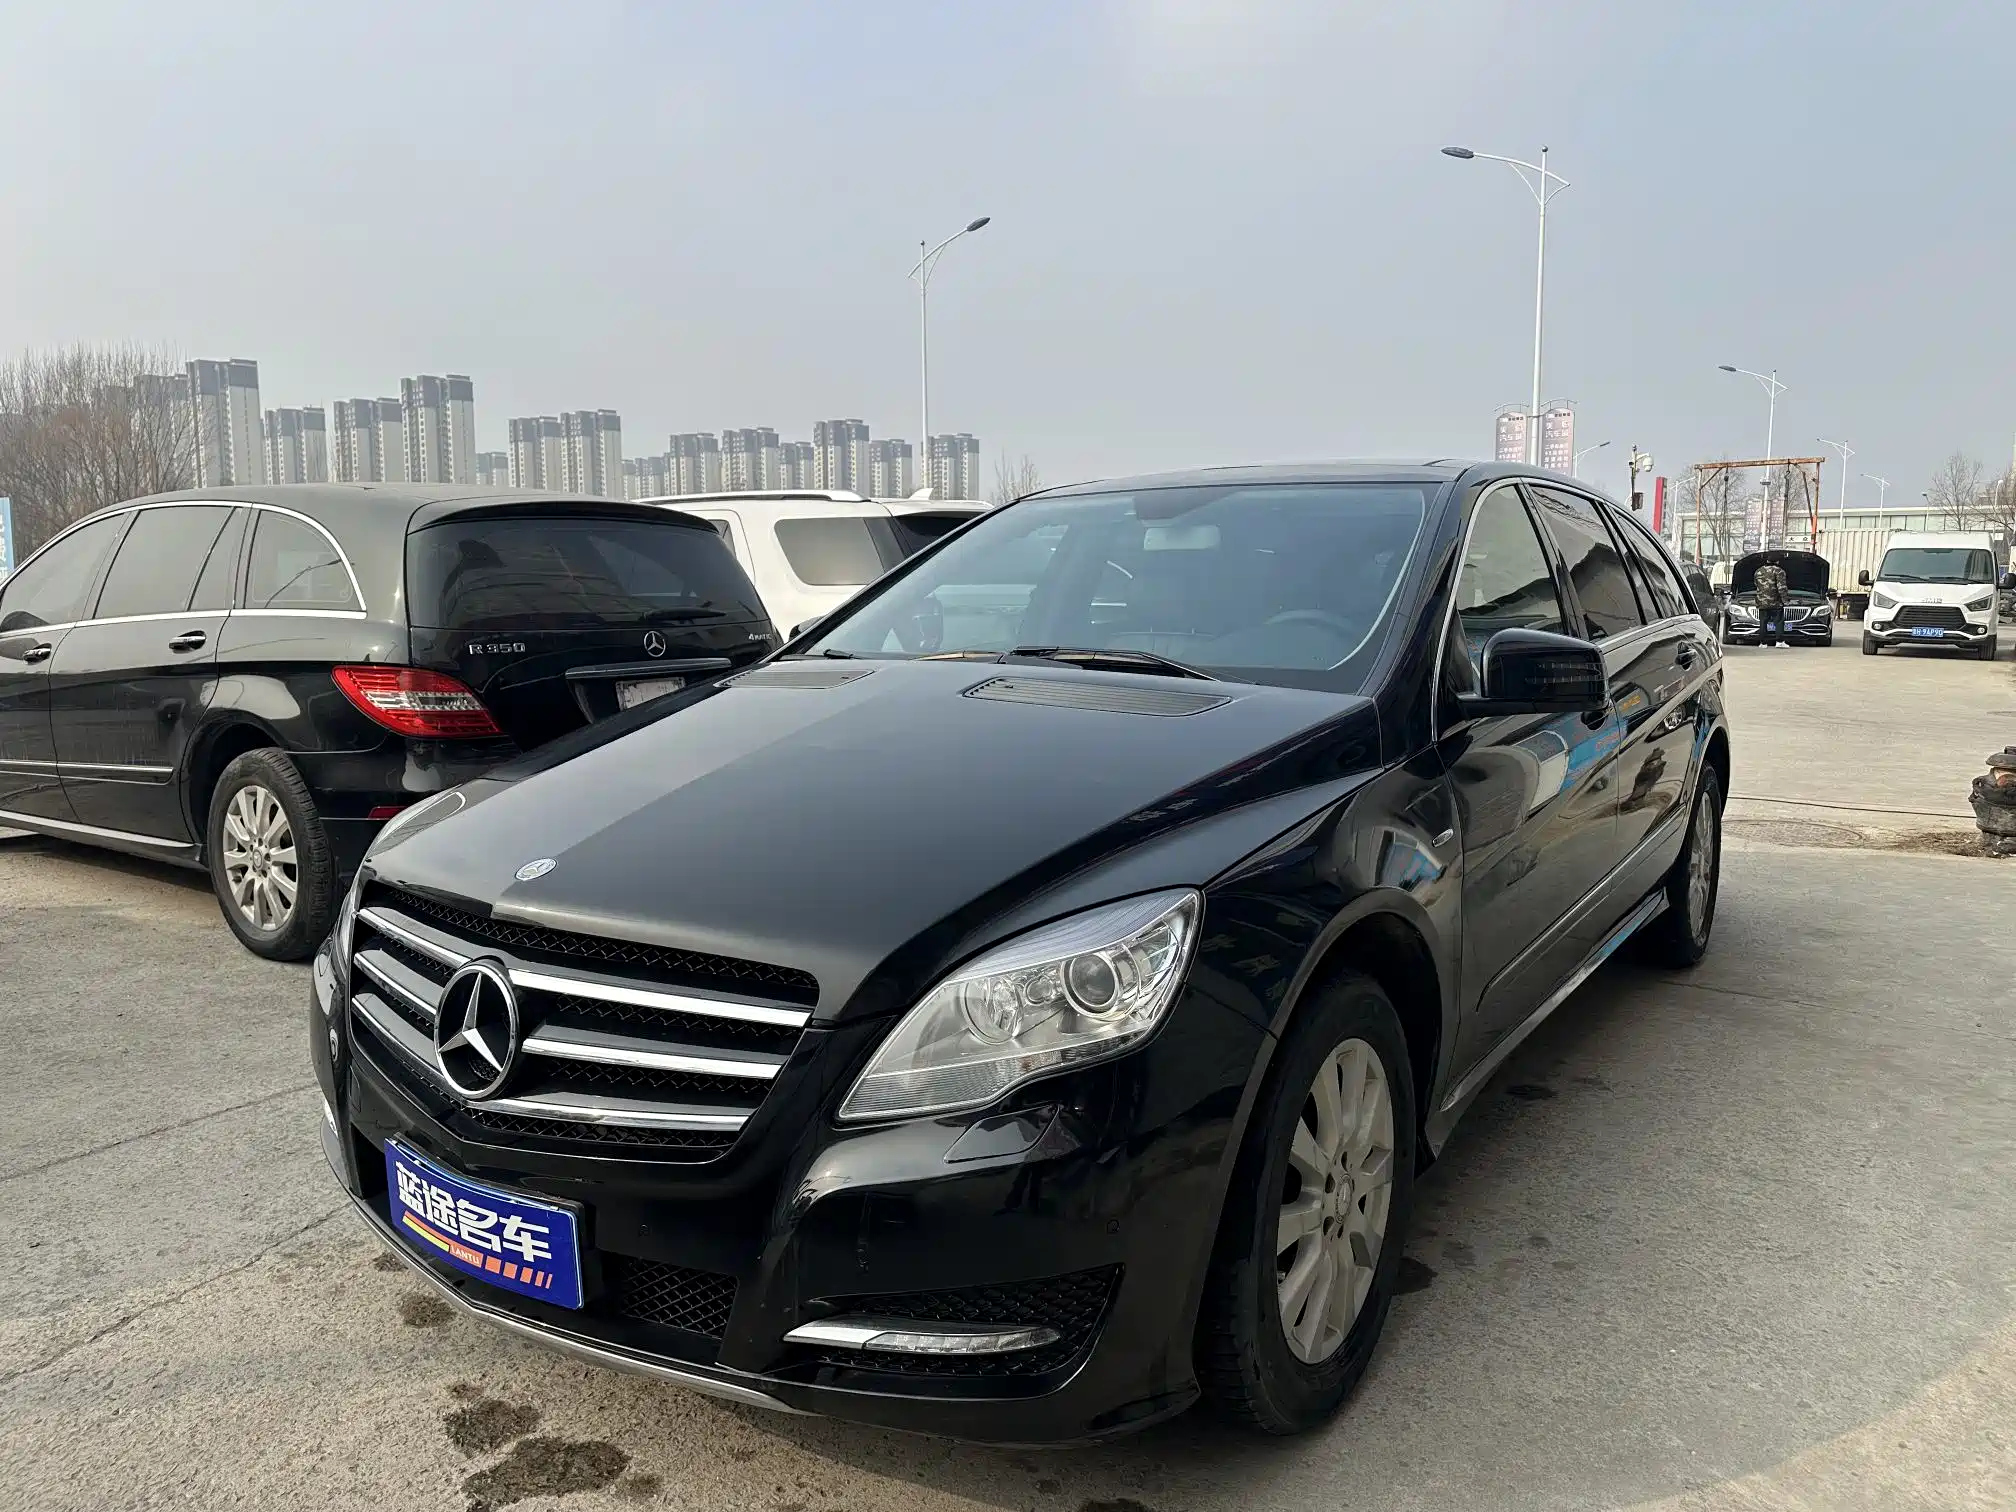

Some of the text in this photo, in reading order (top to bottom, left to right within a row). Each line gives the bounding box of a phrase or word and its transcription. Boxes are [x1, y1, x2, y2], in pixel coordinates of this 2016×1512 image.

[468, 643, 526, 655] R 350
[395, 1160, 552, 1263] 蓝途名车
[450, 1244, 480, 1264] LANTU
